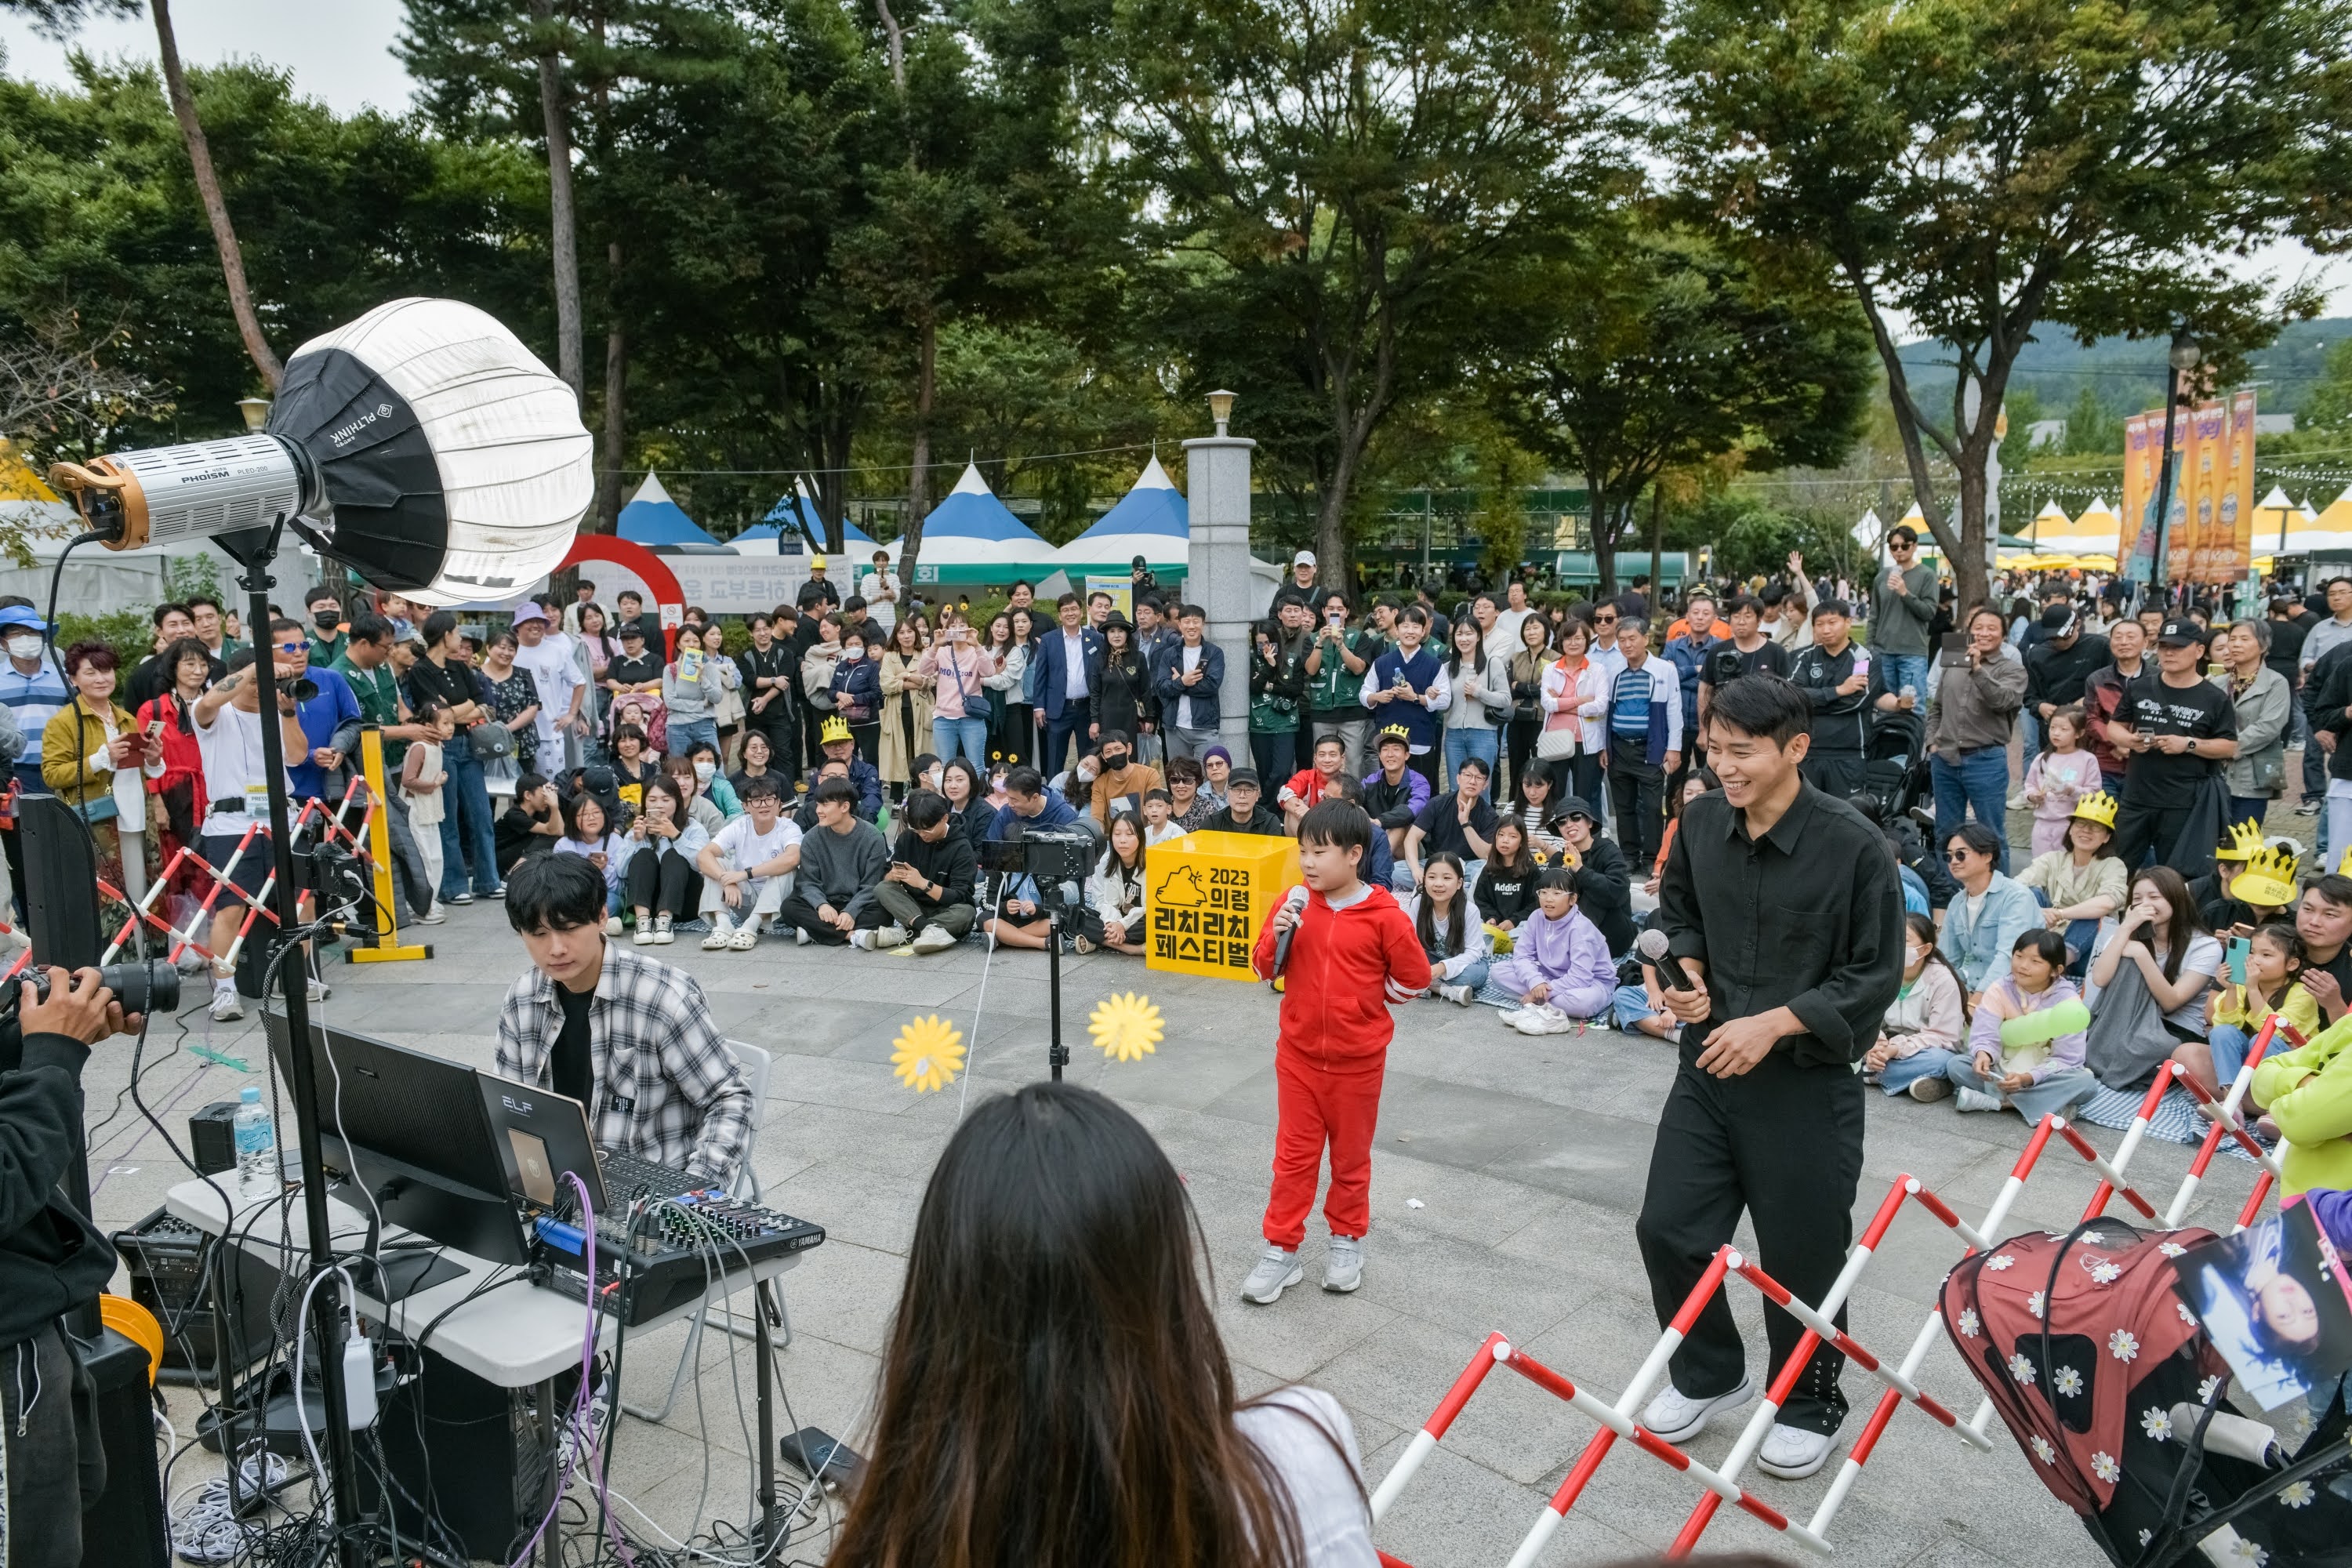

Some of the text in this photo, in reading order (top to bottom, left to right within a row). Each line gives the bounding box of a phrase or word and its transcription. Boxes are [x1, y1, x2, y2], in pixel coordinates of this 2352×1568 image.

[330, 412, 376, 443] PLTHINK
[238, 466, 268, 474] PLED-200
[2210, 550, 2240, 564] Kelly
[2165, 624, 2178, 635] B
[1210, 868, 1250, 887] 2023
[1494, 883, 1522, 892] AddicT
[1210, 887, 1250, 912] 의령
[1155, 907, 1250, 939] 리치리치
[1155, 933, 1250, 968] 페스티벌
[502, 1094, 533, 1113] ELF
[798, 1233, 822, 1247] YAMAHA
